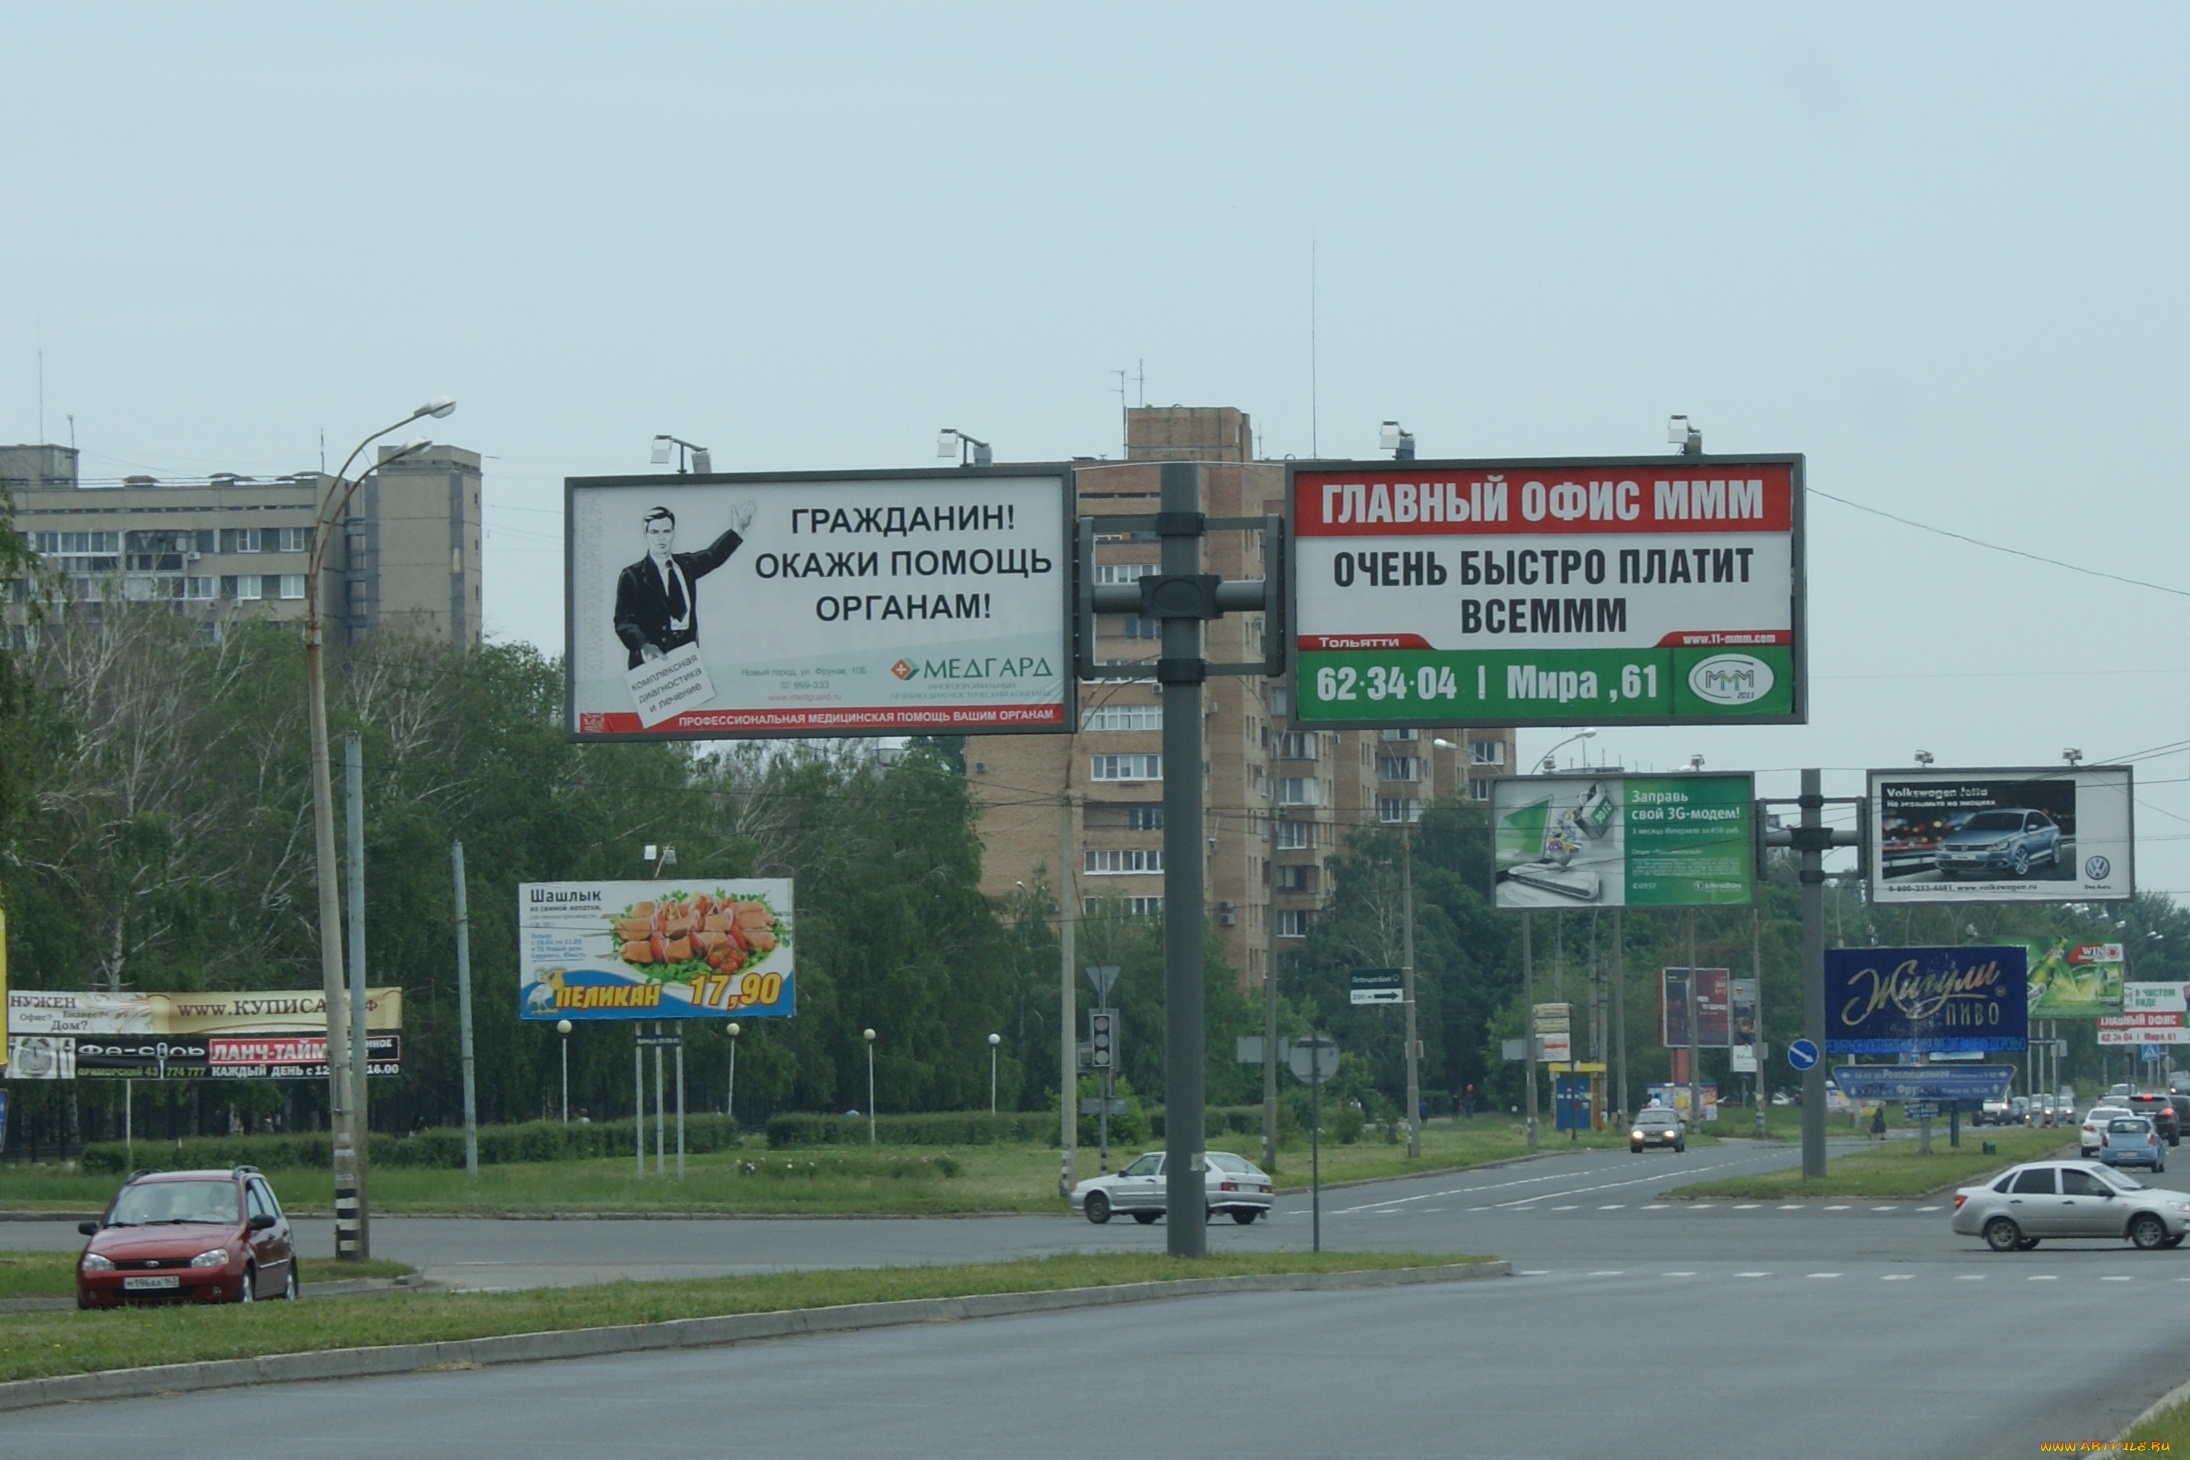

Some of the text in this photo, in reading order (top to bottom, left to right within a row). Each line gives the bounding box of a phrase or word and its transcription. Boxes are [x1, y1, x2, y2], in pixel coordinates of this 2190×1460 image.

[1322, 474, 1763, 524] ГЛАВНЫЙ ОФИС МММ
[791, 504, 1015, 538] ГРАЖДАНИН!
[755, 548, 1052, 579] ОКАЖИ ПОМОЩЬ
[1333, 547, 1754, 587] ОЧЕНЬ БЫСТРО ПЛАТИТ
[816, 593, 991, 621] ОРГАНАМ!
[1461, 597, 1627, 634] ВСЕМММ
[1318, 637, 1400, 648] Тольятти
[631, 654, 698, 691] комплексная
[923, 656, 1053, 679] МЕДГАРД
[638, 668, 702, 704] диагностика
[1506, 665, 1598, 703] Мира
[649, 683, 703, 713] и лечение
[679, 709, 1053, 727] ПРОФЕССИОНАЛЬНАЯ МЕДИЦИНСКАЯ ПОМОЩЬ ВАШИМ ОРГАНАМ
[1632, 790, 1689, 805] Заправь
[1886, 787, 1957, 799] Volkswagen
[1631, 806, 1740, 821] свой 3G-модем!
[530, 889, 602, 903] Шашлык
[10, 996, 77, 1009] НУЖЕН
[554, 984, 662, 1008] ПЕЛИКАН
[689, 972, 783, 1011] 17,90
[51, 1020, 88, 1032] Дом?
[1945, 1001, 2000, 1026] ПИВО
[212, 1063, 267, 1079] КАЖДЫЙ
[271, 1064, 304, 1077] ДЕНЬ
[306, 1068, 313, 1076] с
